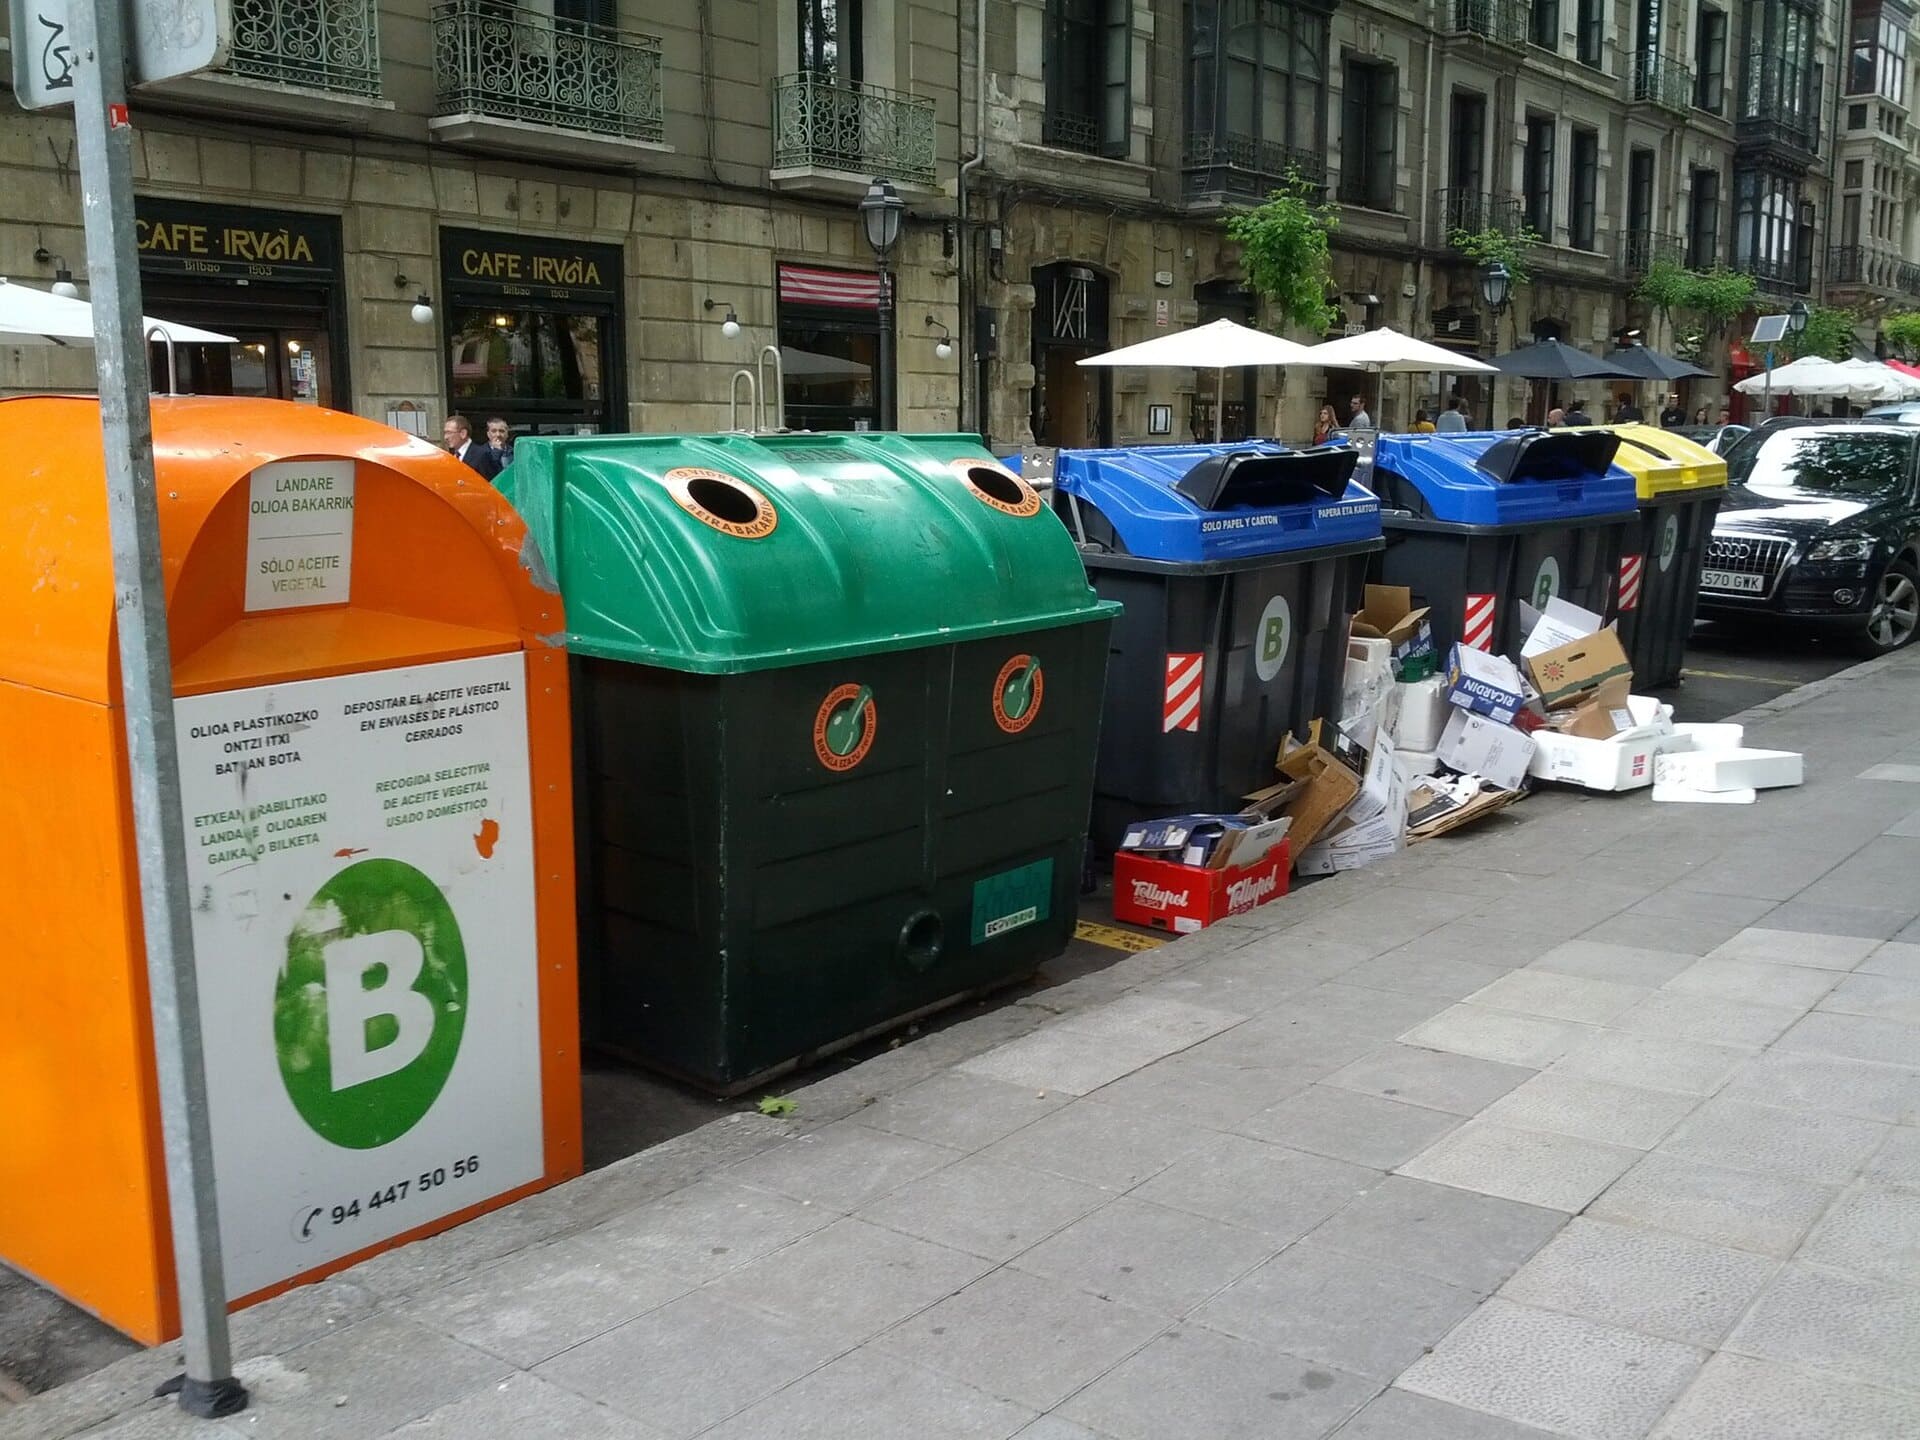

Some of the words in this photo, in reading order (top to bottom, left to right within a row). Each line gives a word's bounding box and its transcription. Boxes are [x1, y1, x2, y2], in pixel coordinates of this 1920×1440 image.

[135, 219, 209, 253] CAFE
[462, 249, 522, 279] CAFE
[275, 477, 335, 493] LANDARE
[251, 499, 289, 514] OLIOA
[292, 496, 354, 512] BAKARRIK
[1318, 507, 1342, 519] PAPERA
[1342, 505, 1353, 516] ETA
[1202, 520, 1222, 533] SOLO
[1223, 518, 1244, 530] PAPEL
[1245, 517, 1251, 528] Y
[260, 557, 295, 575] SÓLO
[297, 555, 340, 571] ACEITE
[271, 576, 328, 593] VEGETAL
[1701, 572, 1730, 587] 570
[1734, 575, 1761, 589] GWK
[1536, 574, 1552, 610] B
[1263, 616, 1283, 661] B
[343, 696, 407, 716] DEPOSITAR
[409, 694, 422, 706] EL
[425, 687, 464, 704] ACEITE
[466, 681, 511, 697] VEGETAL
[190, 722, 230, 739] OLIOA
[233, 709, 319, 732] PLASTIKOZKO
[360, 719, 376, 732] EN
[379, 711, 429, 729] ENVASES
[431, 708, 446, 721] DE
[223, 737, 262, 754] ONTZI
[266, 733, 290, 747] ITXI
[405, 724, 464, 743] CERRADOS
[269, 751, 302, 766] BOTA
[375, 773, 432, 793] RECOGIDA
[434, 762, 491, 782] SELECTIVA
[383, 797, 399, 810] DE
[400, 789, 440, 807] ACEITE
[441, 780, 489, 798] VEGETAL
[266, 812, 327, 833] OLIOAREN
[386, 811, 424, 828] USADO
[207, 844, 266, 865] GAIKAO
[269, 833, 320, 853] BILKETA
[323, 928, 435, 1092] B
[331, 1199, 361, 1225] 94
[368, 1179, 410, 1210] 447
[419, 1168, 446, 1192] 50
[453, 1155, 480, 1179] 56
